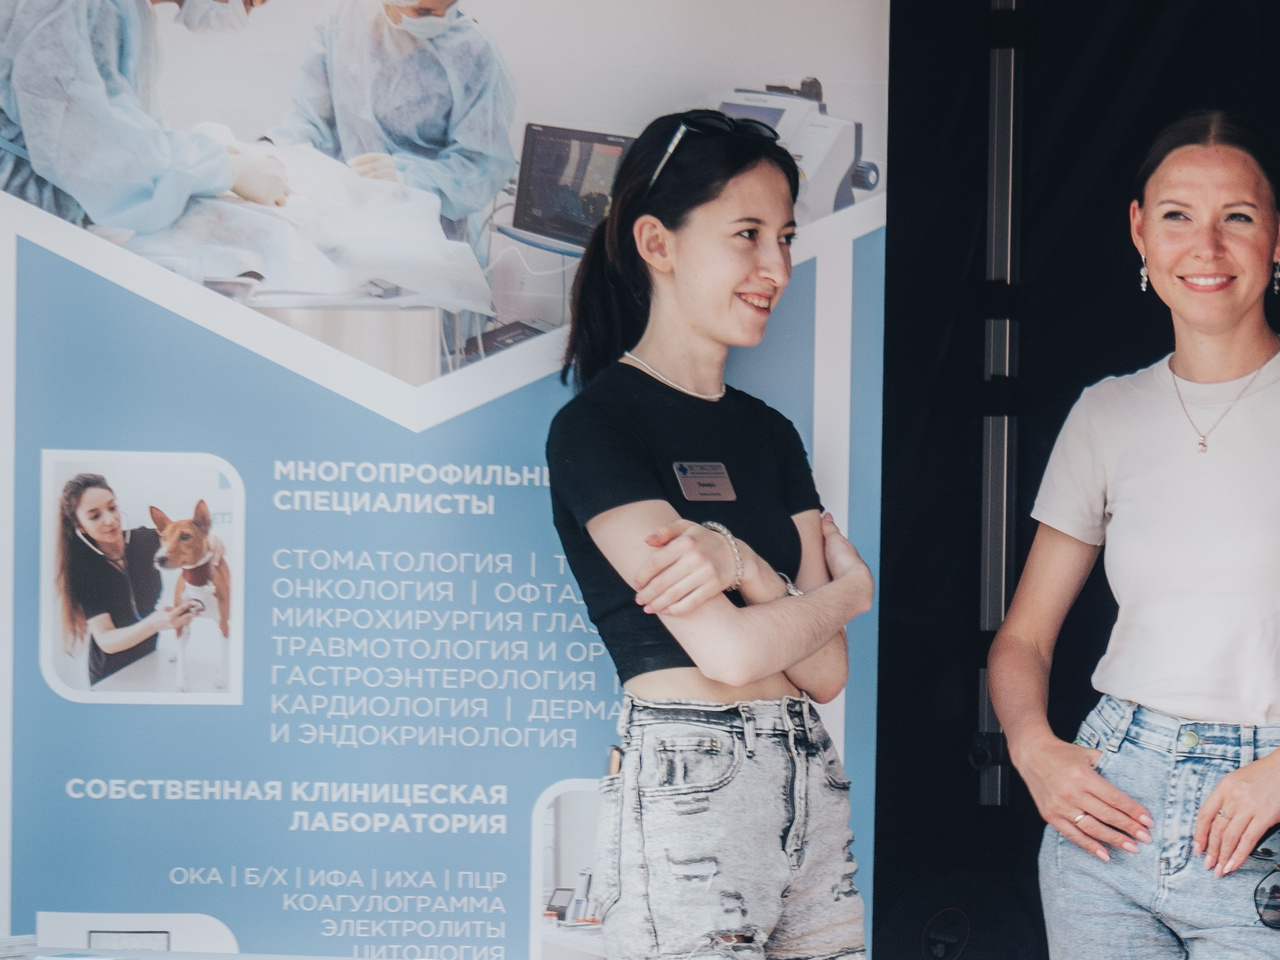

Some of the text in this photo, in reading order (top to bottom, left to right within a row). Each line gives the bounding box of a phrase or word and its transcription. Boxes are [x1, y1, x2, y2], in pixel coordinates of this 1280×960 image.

[273, 460, 550, 487] МНОГОПРОФИЛЬН
[273, 490, 495, 516] СПЕЦИАЛИСТЫ
[271, 549, 513, 575] СТОМАТОЛОГИЯ
[271, 578, 585, 605] ОНКОЛОГИЯ ОФТА
[271, 607, 599, 634] МИКРОХИРУРГИЯ ГЛА
[270, 636, 528, 662] ТРАВМОТОЛОГИЯ
[538, 642, 557, 661] И
[270, 665, 596, 692] ГАСТРОЭНТЕРОЛОГИЯ
[270, 694, 488, 719] КАРДИОЛОГИЯ
[269, 723, 577, 749] И ЭНДОКРИНОЛОГИЯ
[65, 778, 508, 807] СОБСТВЕННАЯ КЛИНИЦЕСКАЯ
[289, 811, 508, 834] ЛАБОРАТОРИЯ
[168, 867, 508, 892] ОКА Б/Х ИФА ИХА ПЦР
[282, 894, 507, 914] КОАГУЛОГРАММА
[320, 919, 506, 938] ЭЛЕКТРОЛИТЫ
